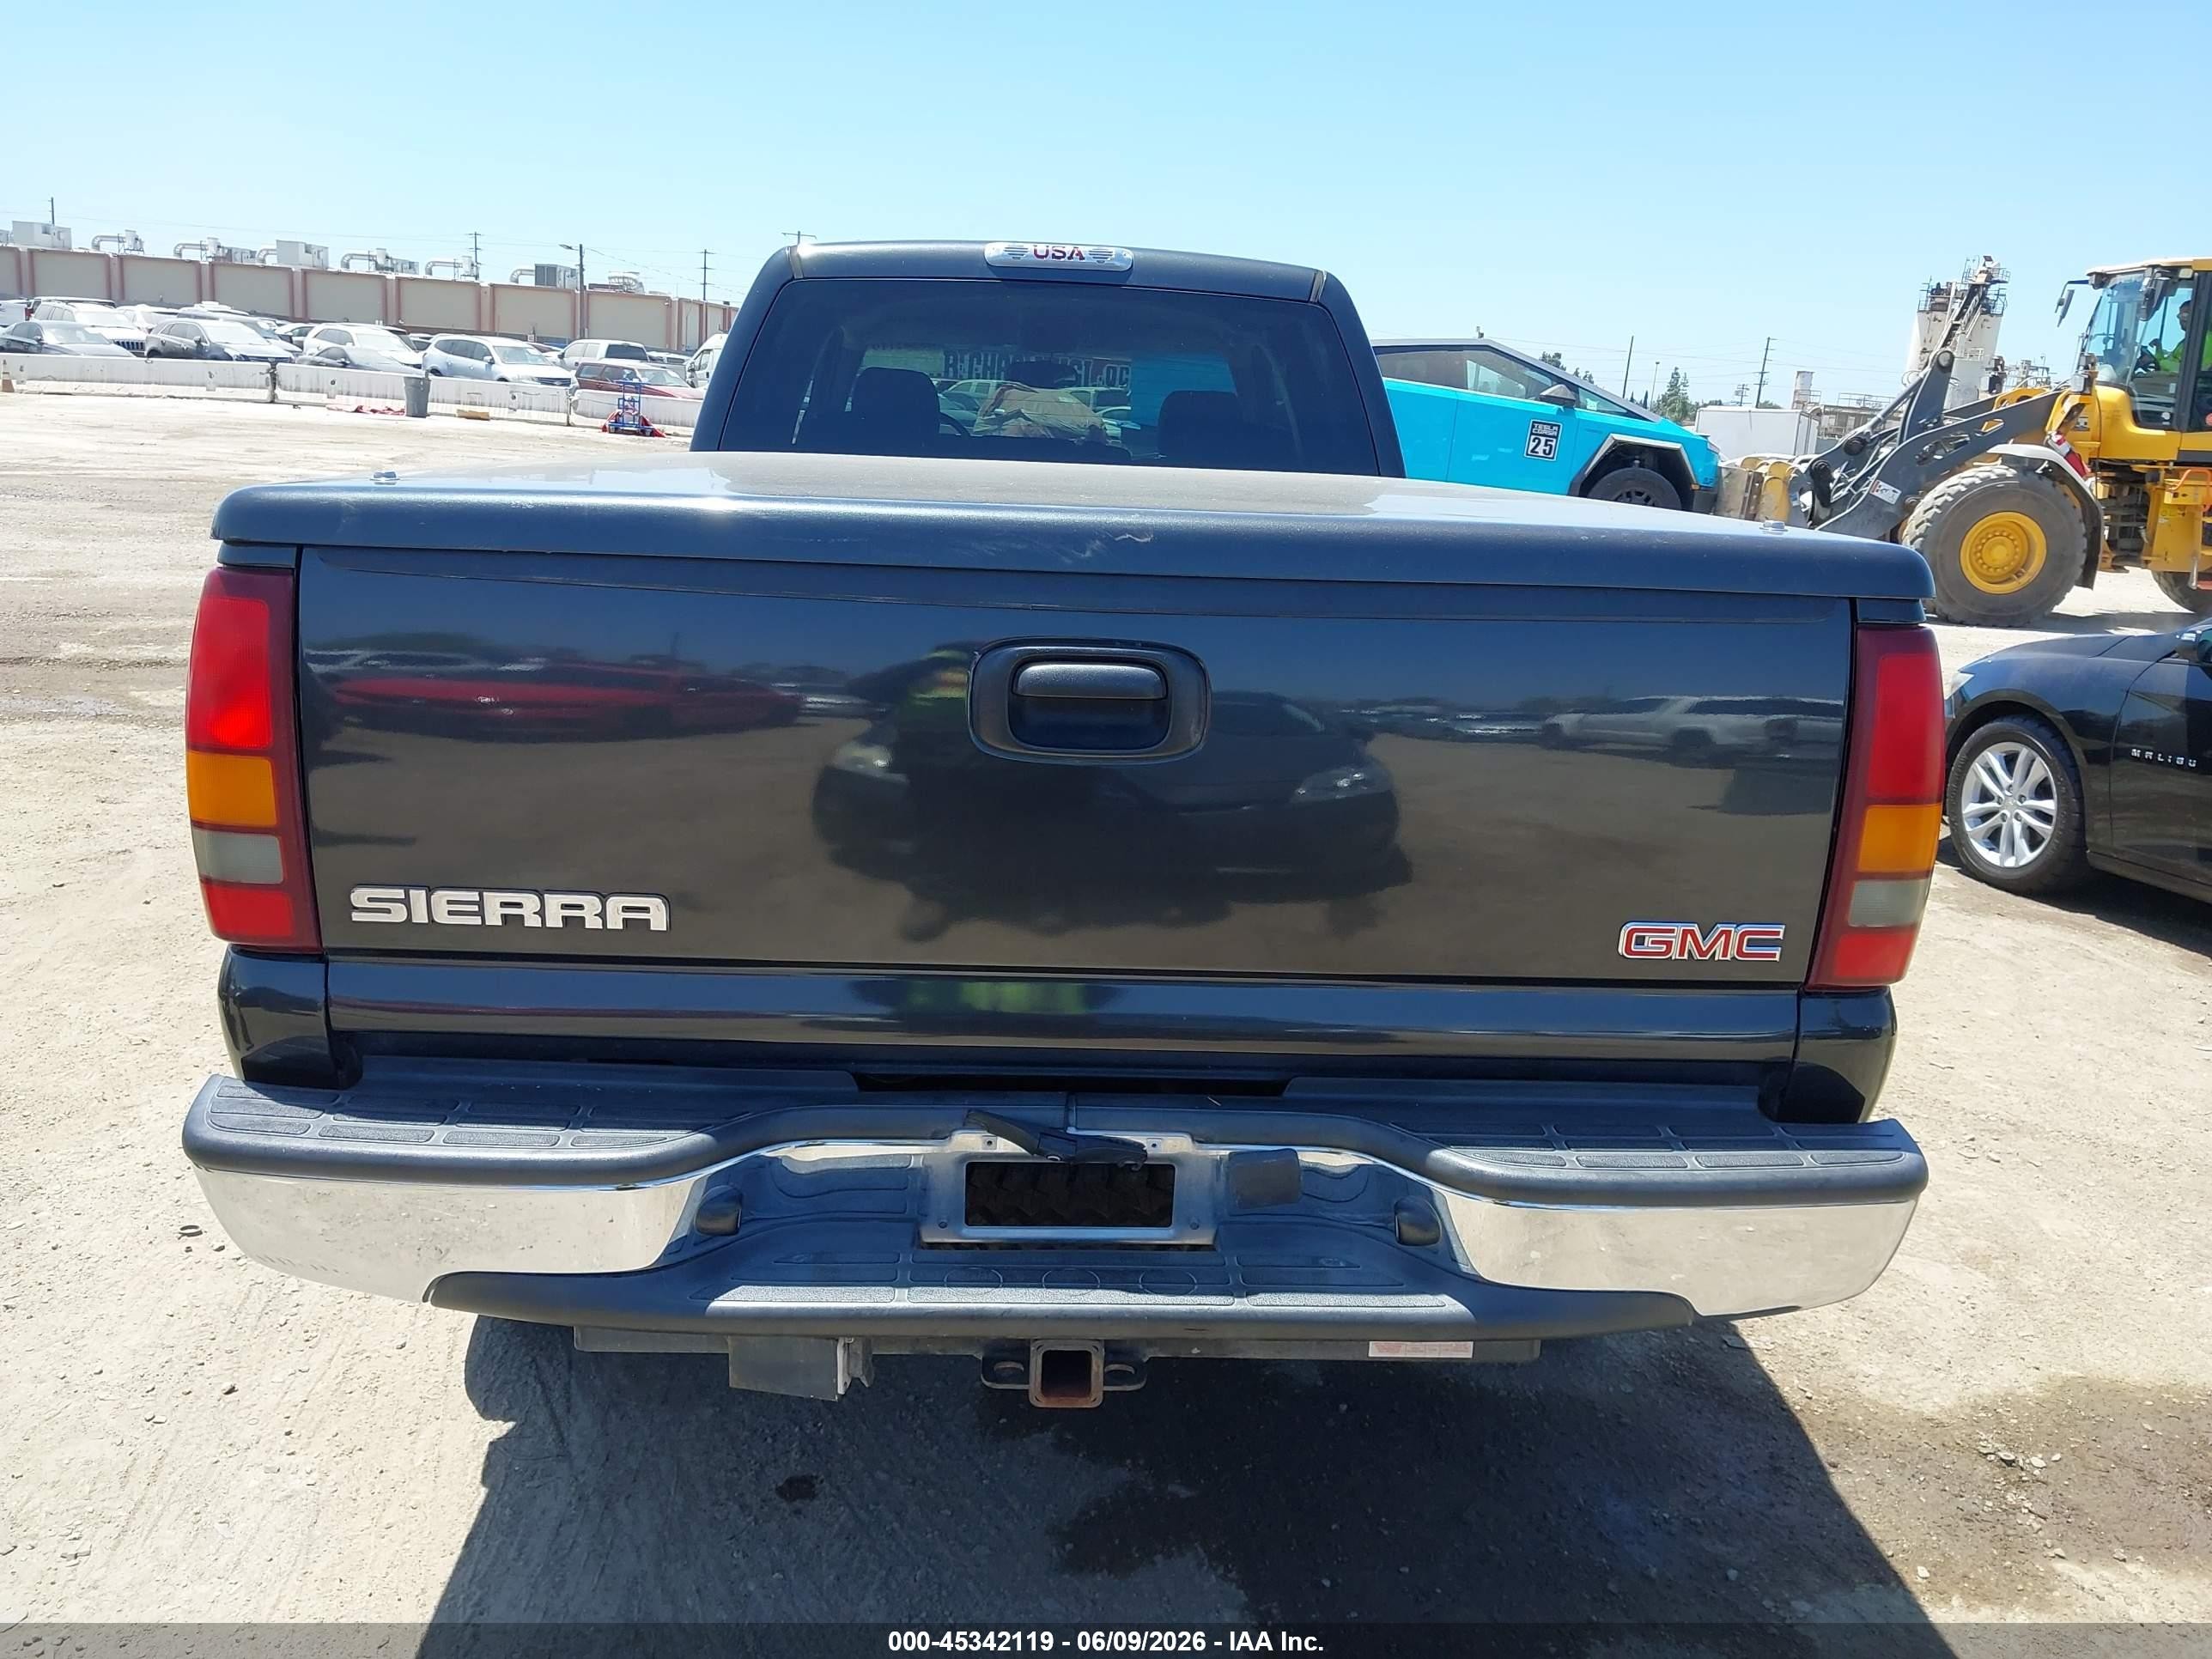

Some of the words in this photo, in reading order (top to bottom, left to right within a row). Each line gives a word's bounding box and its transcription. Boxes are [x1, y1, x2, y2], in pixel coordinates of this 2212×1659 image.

[1032, 245, 1085, 261] USA
[1530, 437, 1554, 456] 25
[2130, 748, 2197, 768] MALIBU
[350, 884, 671, 932] SIERRA
[1618, 921, 1785, 962] GMC
